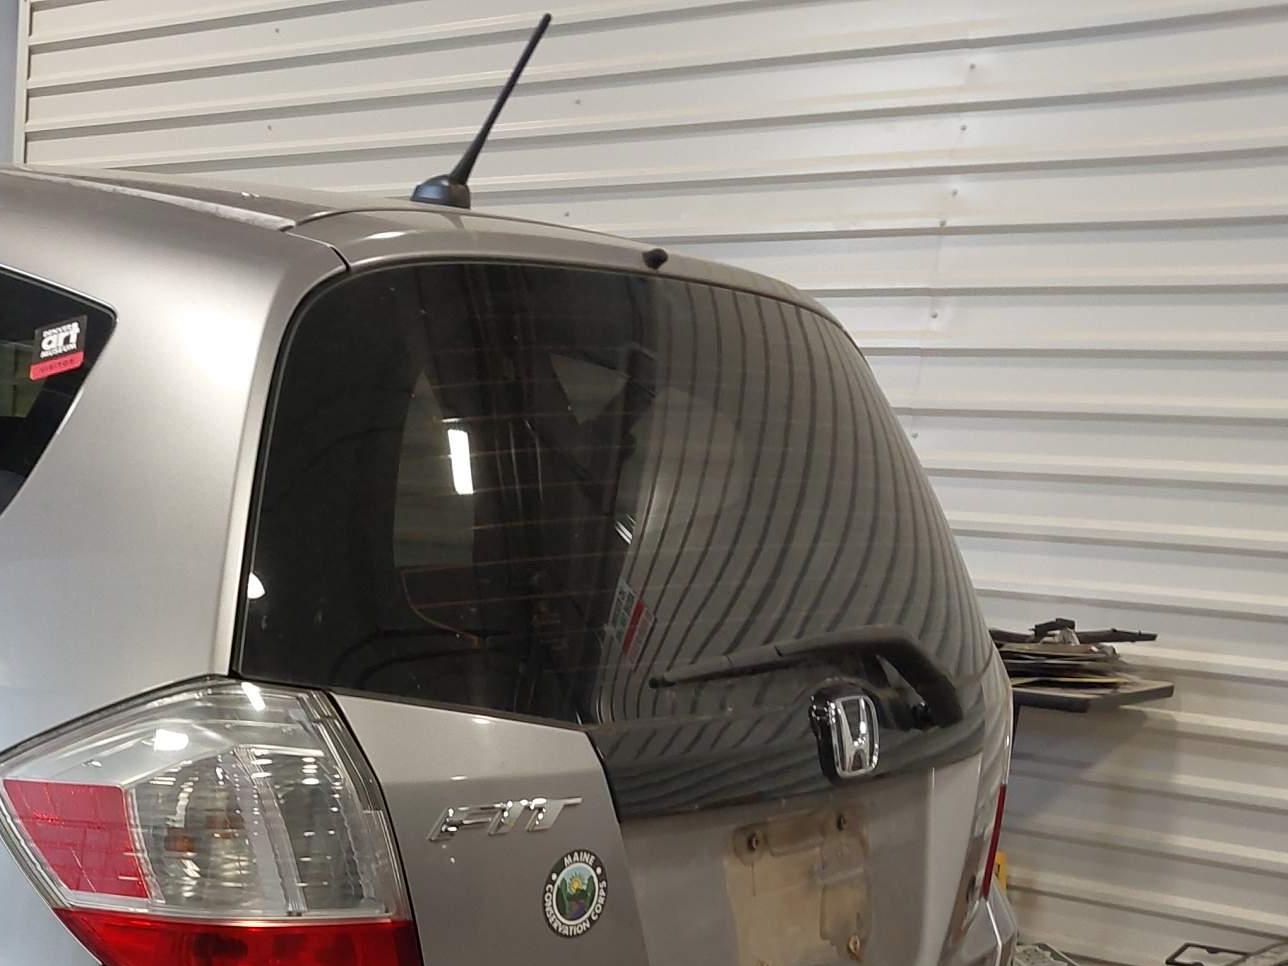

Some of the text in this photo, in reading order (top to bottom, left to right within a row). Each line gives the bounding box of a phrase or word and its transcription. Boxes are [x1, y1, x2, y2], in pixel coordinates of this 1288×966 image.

[41, 322, 81, 351] art
[564, 851, 596, 867] MAINE
[544, 880, 607, 937] CONSERVATION CORPS
